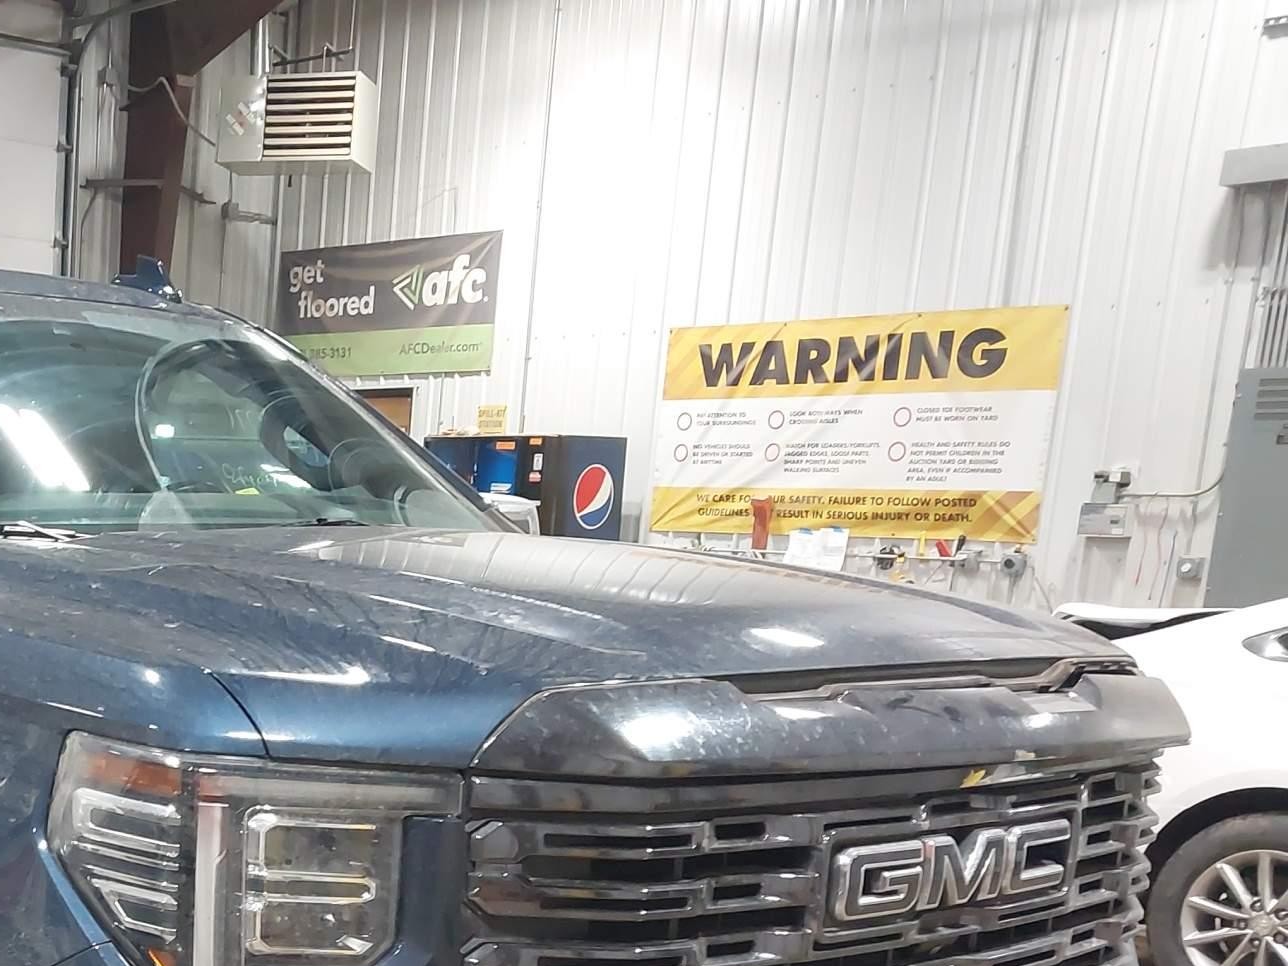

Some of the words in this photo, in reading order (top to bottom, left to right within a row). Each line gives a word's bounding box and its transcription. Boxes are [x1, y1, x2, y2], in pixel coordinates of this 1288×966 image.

[289, 259, 325, 293] get
[298, 285, 375, 318] floored
[399, 341, 480, 356] AFCDealer.com
[699, 327, 1008, 388] WARNING
[697, 494, 710, 502] WE
[712, 494, 737, 503] CARE
[739, 494, 752, 503] FO
[828, 496, 867, 506] FAILURE
[870, 496, 884, 506] TO
[887, 497, 932, 507] FOLLOW
[934, 497, 977, 508] POSTED
[697, 507, 750, 517] GUIDELINES
[776, 509, 810, 519] RESULT
[813, 509, 824, 519] IN
[826, 510, 869, 521] SERIOUS
[871, 511, 911, 521] INJURY
[914, 512, 930, 522] OR
[934, 512, 973, 522] DEATH.
[834, 818, 1071, 922] GMC
